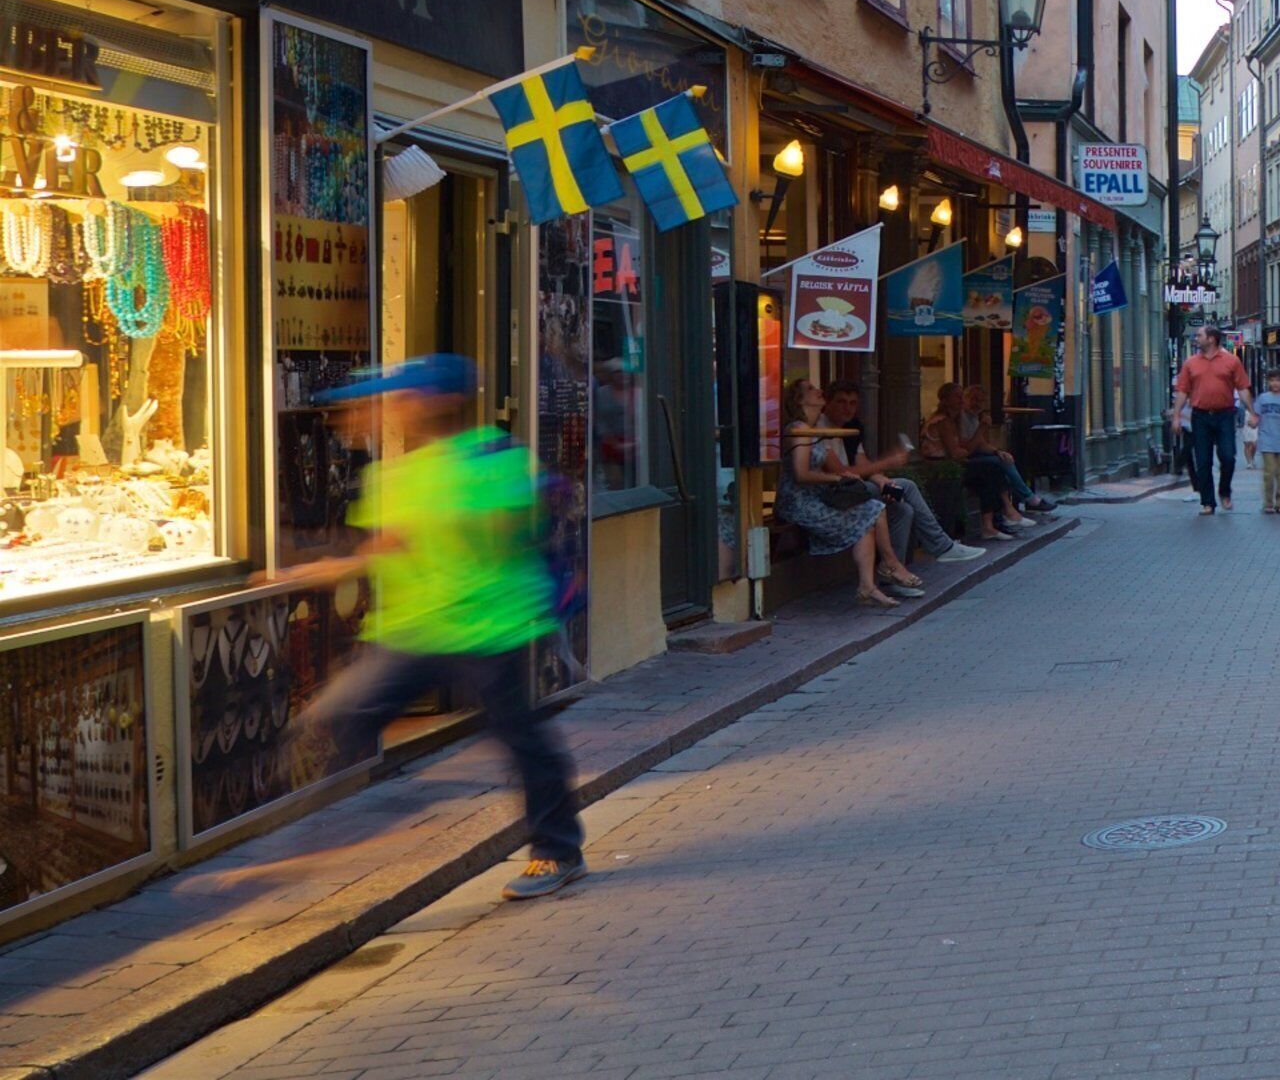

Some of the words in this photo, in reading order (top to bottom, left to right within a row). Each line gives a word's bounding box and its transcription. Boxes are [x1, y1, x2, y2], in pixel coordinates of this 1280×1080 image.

[1085, 146, 1137, 158] PRESENTER
[1083, 158, 1143, 170] SOUVENIRER
[1084, 172, 1144, 194] EPALL
[800, 280, 834, 291] BELGISK
[1164, 284, 1216, 303] Manhattan
